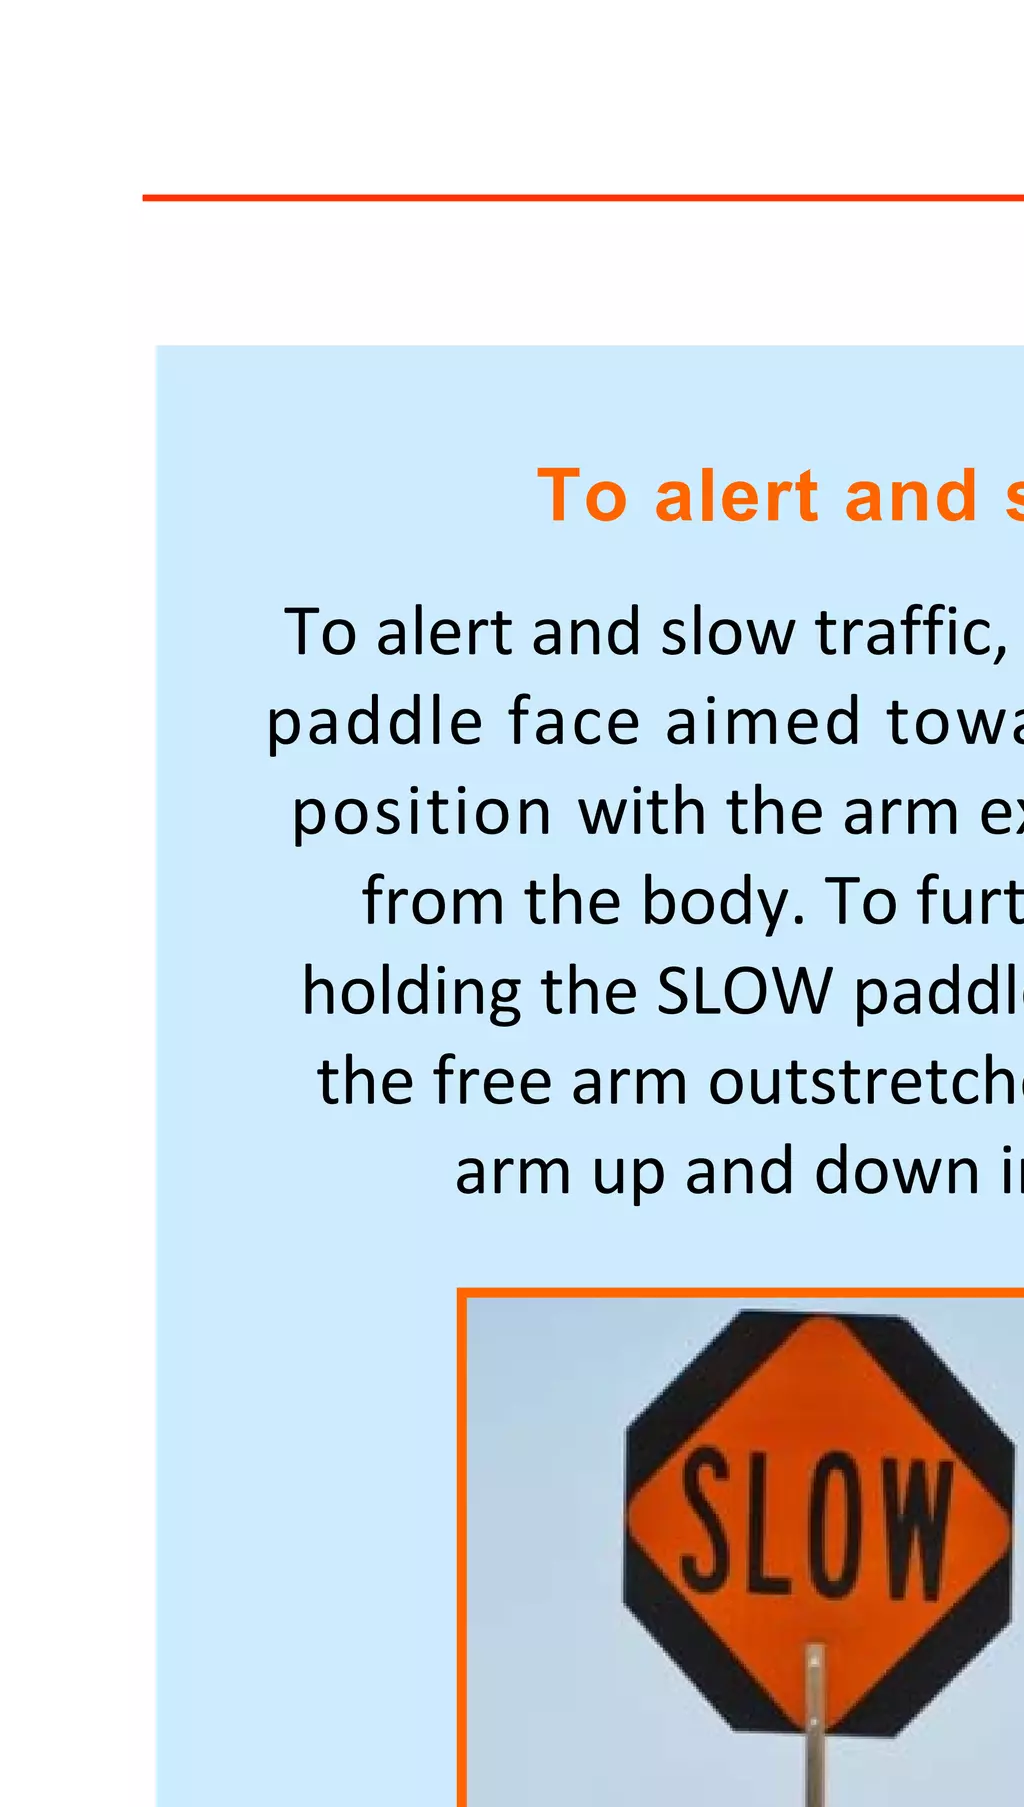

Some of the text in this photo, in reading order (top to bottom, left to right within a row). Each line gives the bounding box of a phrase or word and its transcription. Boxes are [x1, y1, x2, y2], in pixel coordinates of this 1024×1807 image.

[537, 468, 626, 522] To
[656, 468, 818, 522] alert
[846, 468, 975, 521] and
[284, 607, 355, 655] To
[378, 604, 512, 655] alert
[534, 604, 638, 655] and
[662, 604, 796, 655] slow
[815, 604, 1005, 665] traffic,
[270, 694, 481, 757] paddle
[508, 693, 638, 745] face
[667, 694, 857, 745] aimed
[295, 786, 548, 847] position
[578, 783, 704, 834] with
[726, 784, 822, 834] the
[845, 799, 956, 834] arm
[362, 873, 502, 924] from
[524, 873, 620, 924] the
[645, 874, 803, 937] body.
[825, 877, 896, 924] To
[305, 963, 521, 1027] holding
[541, 963, 636, 1014] the
[659, 966, 833, 1014] SLOW
[317, 1053, 412, 1104] the
[433, 1053, 551, 1104] free
[573, 1068, 685, 1104] arm
[457, 1158, 569, 1194] arm
[595, 1158, 664, 1206] up
[687, 1143, 791, 1194] and
[816, 1143, 977, 1194] down
[680, 1444, 955, 1602] SLOW
